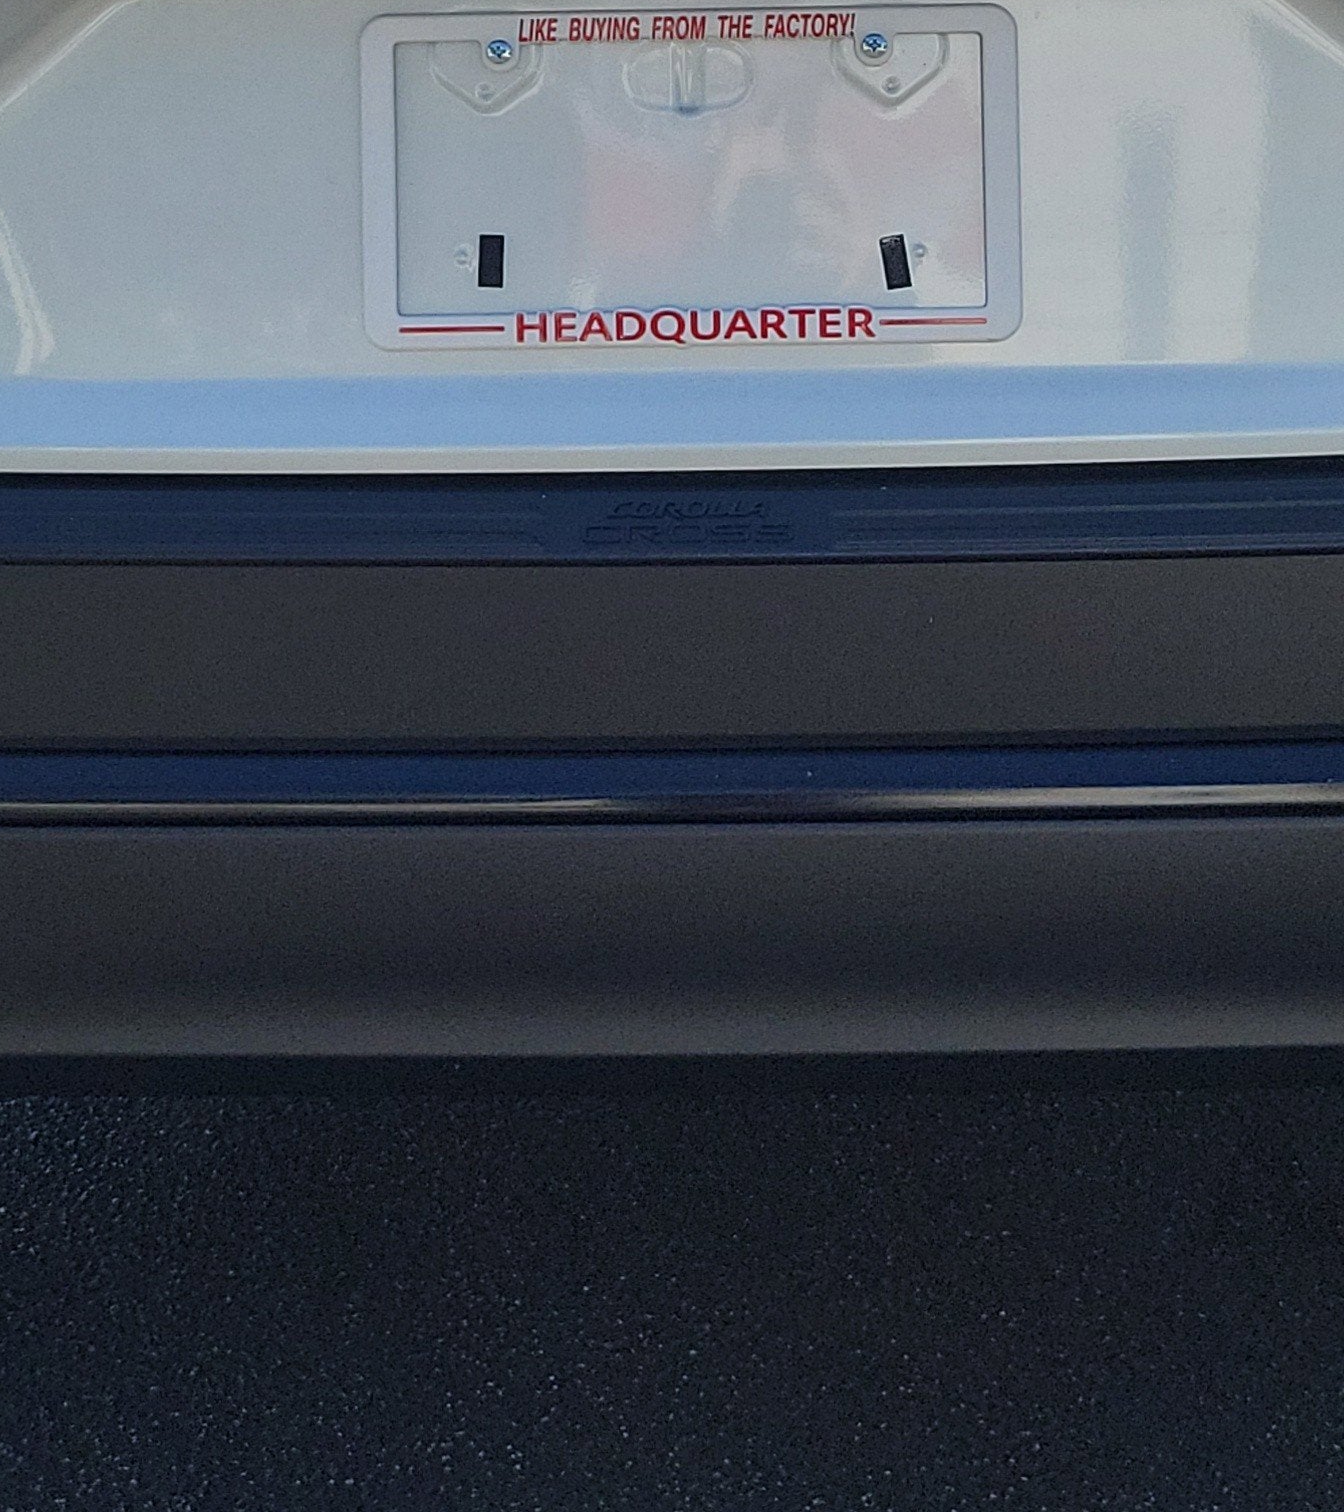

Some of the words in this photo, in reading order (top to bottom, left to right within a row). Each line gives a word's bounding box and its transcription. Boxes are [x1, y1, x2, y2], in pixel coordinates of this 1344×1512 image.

[517, 16, 559, 43] LIKE
[568, 15, 641, 42] BUYING
[651, 14, 707, 40] FROM
[718, 13, 754, 39] THE
[763, 11, 857, 39] FACTORY!
[514, 308, 876, 344] HEADQUARTER
[606, 501, 767, 521] COROLLA
